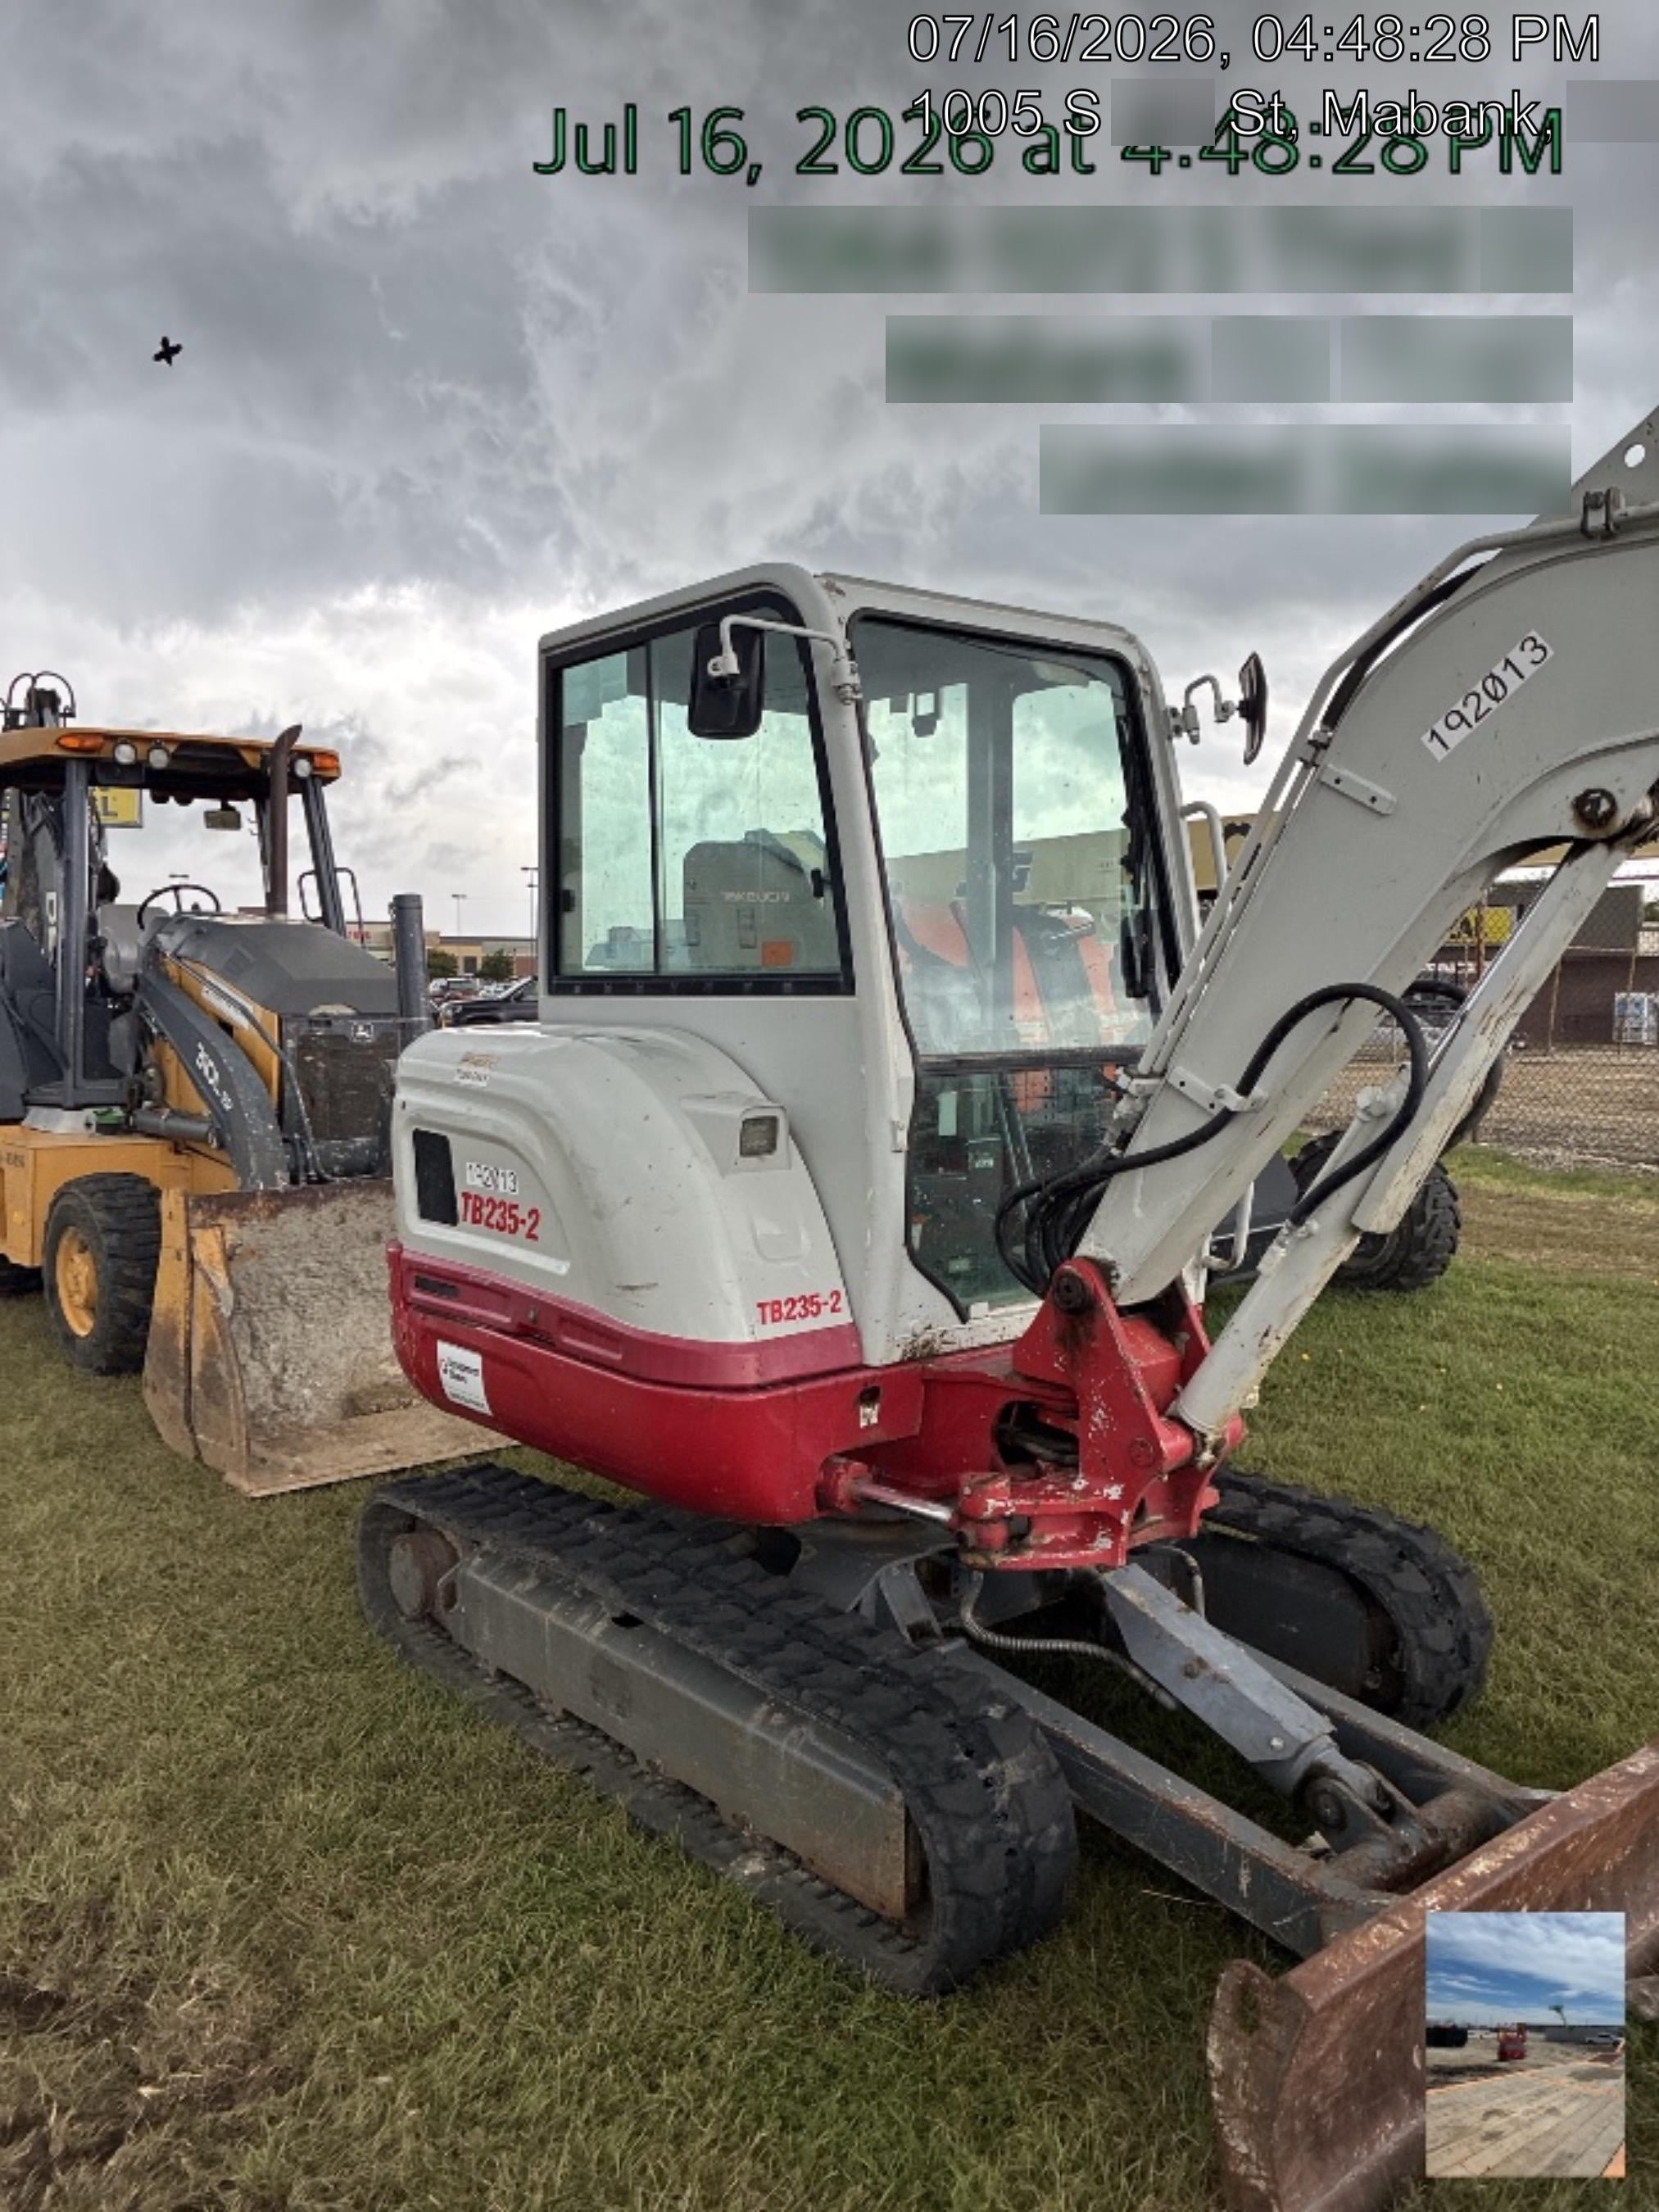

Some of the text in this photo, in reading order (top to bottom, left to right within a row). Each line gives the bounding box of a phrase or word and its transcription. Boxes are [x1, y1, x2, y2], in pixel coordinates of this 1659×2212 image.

[1427, 635, 1548, 751] 192013
[460, 1191, 541, 1242] TB235-2
[756, 1289, 842, 1326] TB235-2
